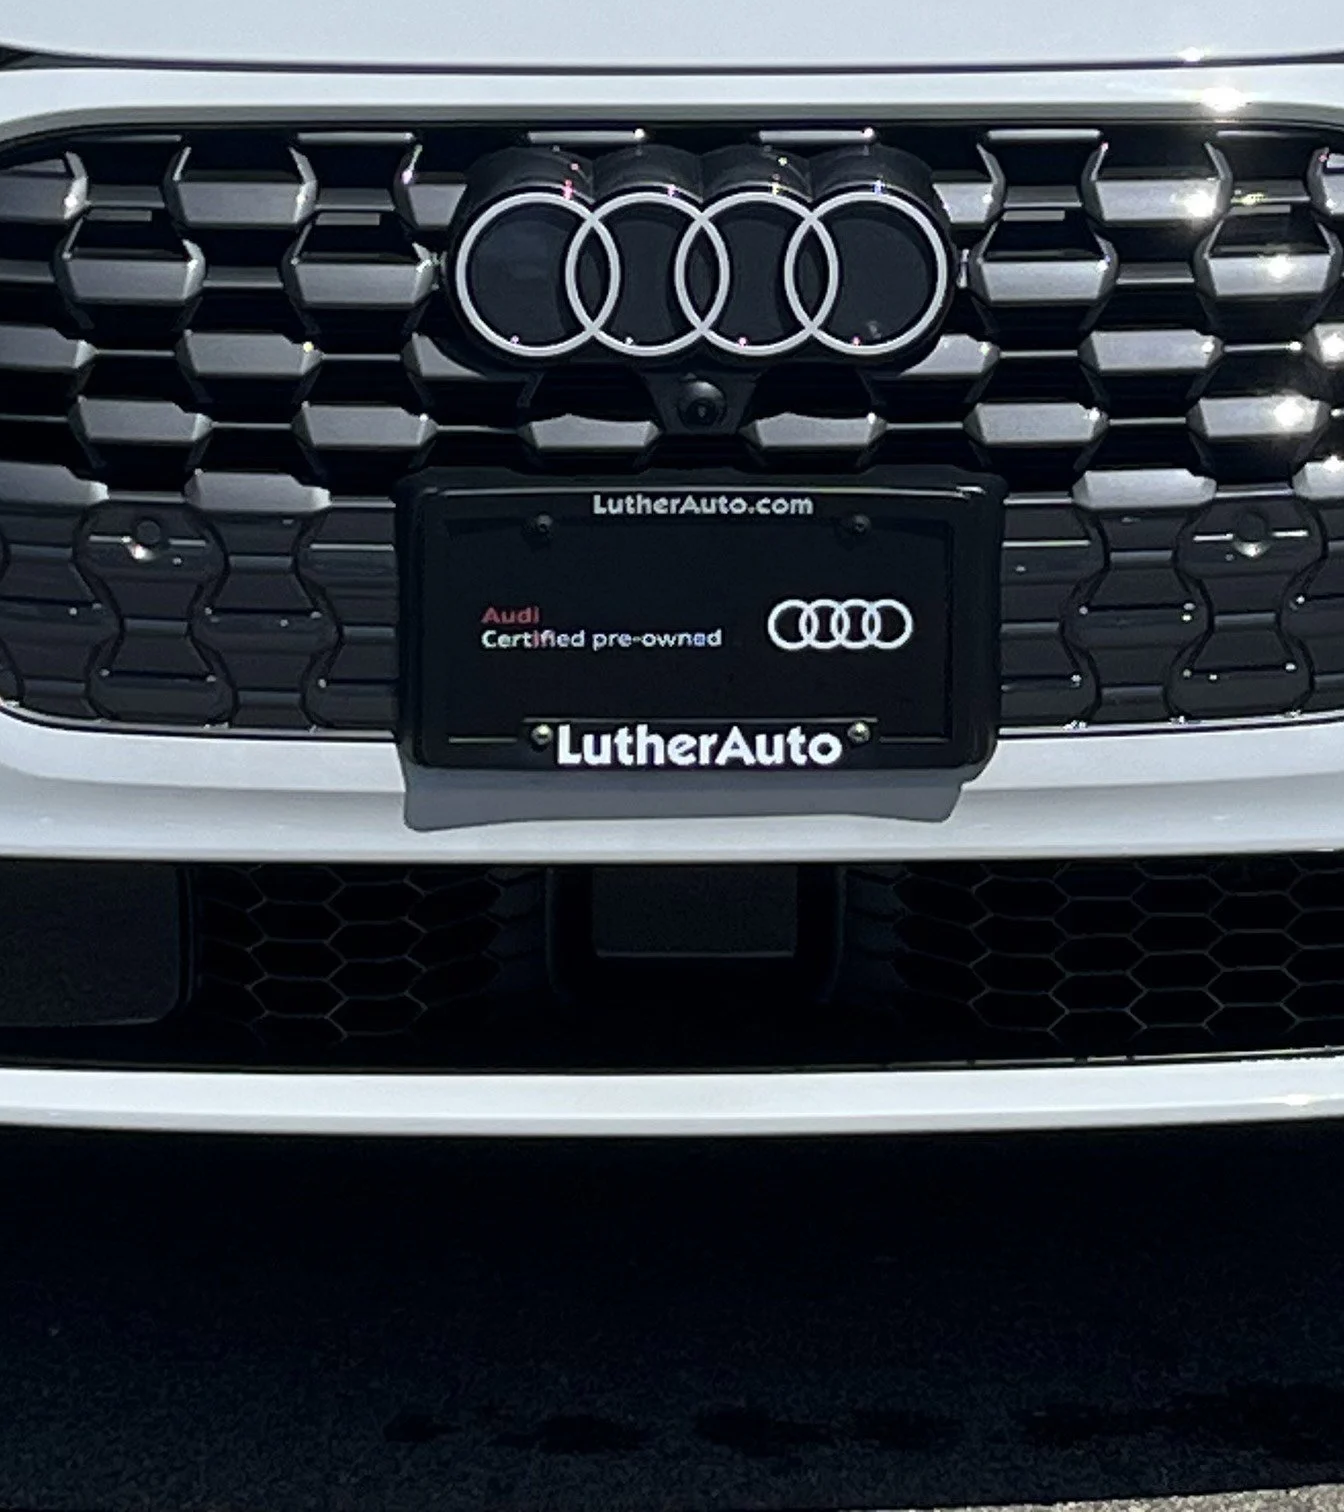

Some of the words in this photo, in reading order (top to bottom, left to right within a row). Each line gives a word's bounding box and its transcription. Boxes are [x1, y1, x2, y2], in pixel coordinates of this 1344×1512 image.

[592, 493, 813, 515] LutherAuto.com
[481, 606, 540, 625] Audi
[481, 629, 585, 649] Certified
[592, 628, 723, 652] pre-owned
[557, 724, 843, 766] LutherAuto
